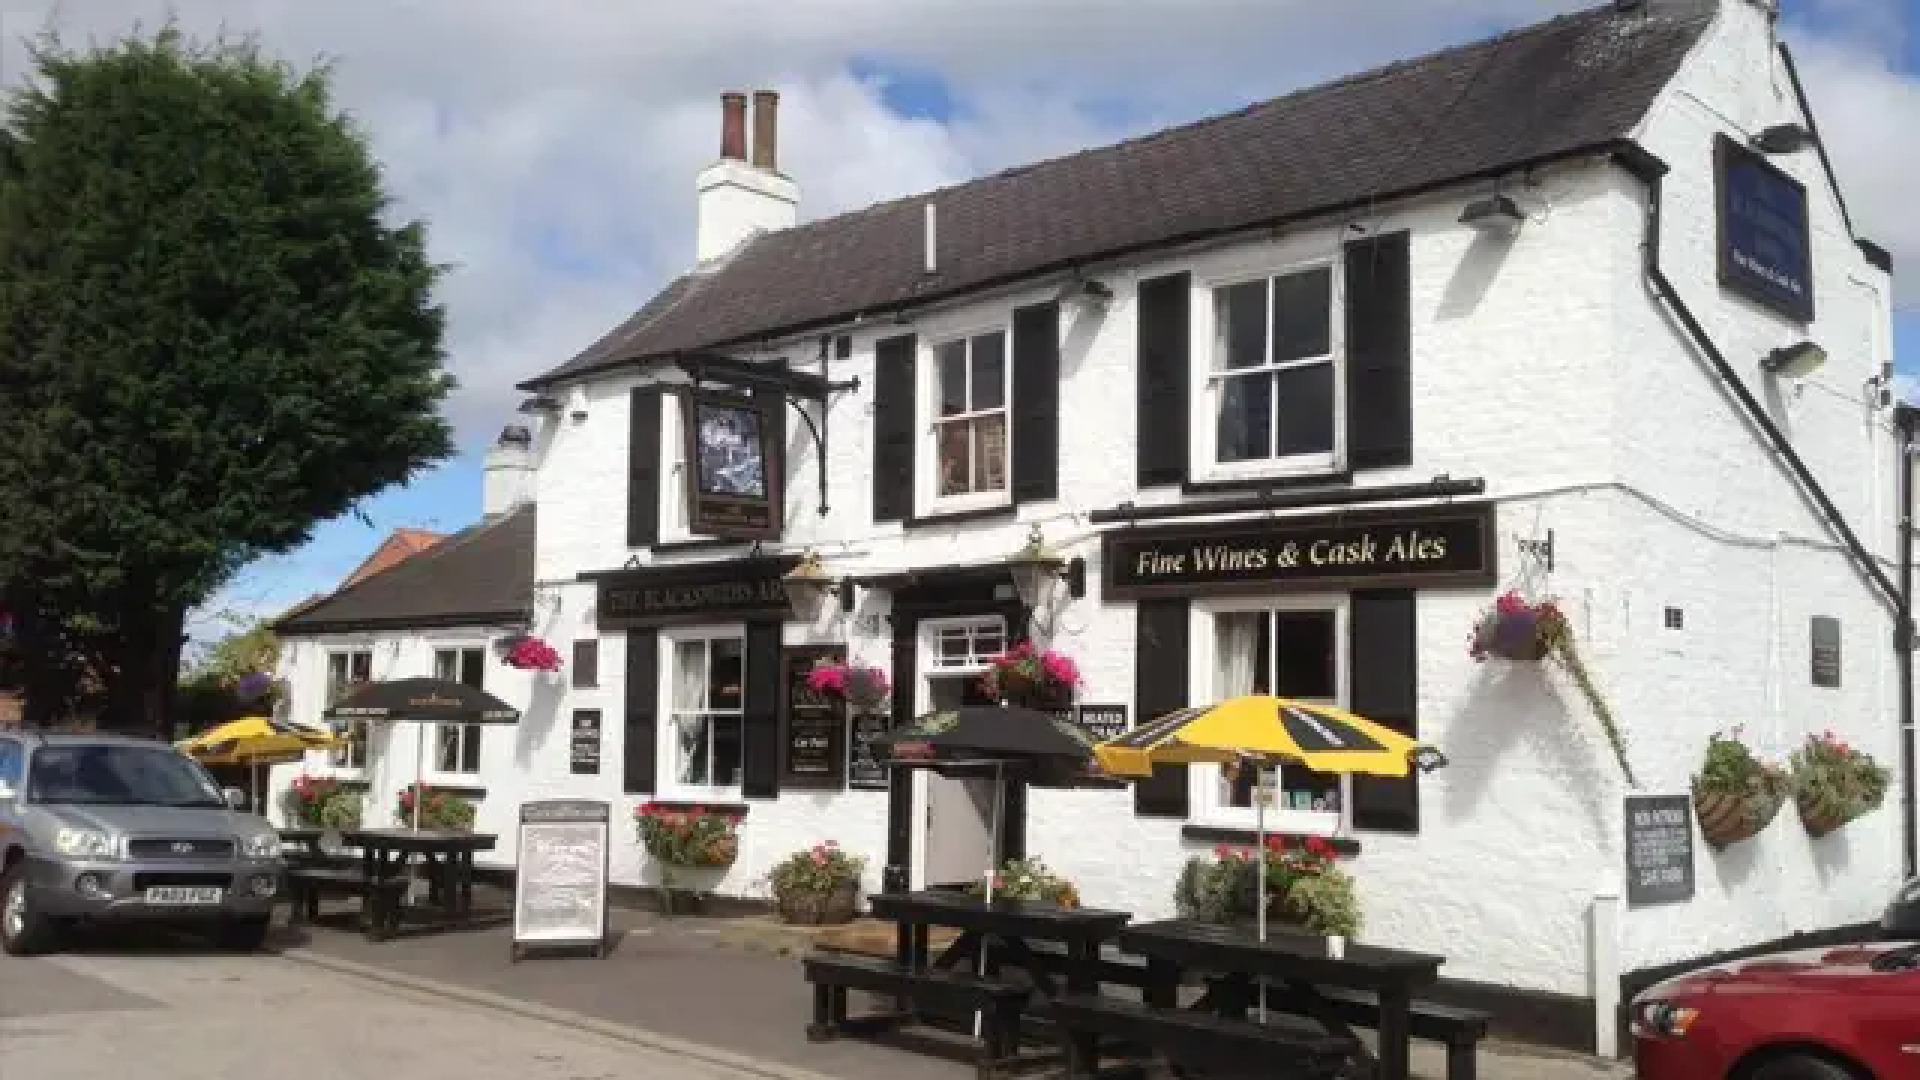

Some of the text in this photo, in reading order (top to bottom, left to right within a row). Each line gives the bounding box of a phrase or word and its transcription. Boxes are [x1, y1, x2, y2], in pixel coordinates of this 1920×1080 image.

[1137, 530, 1447, 577] Fine Wines & Cask Ales
